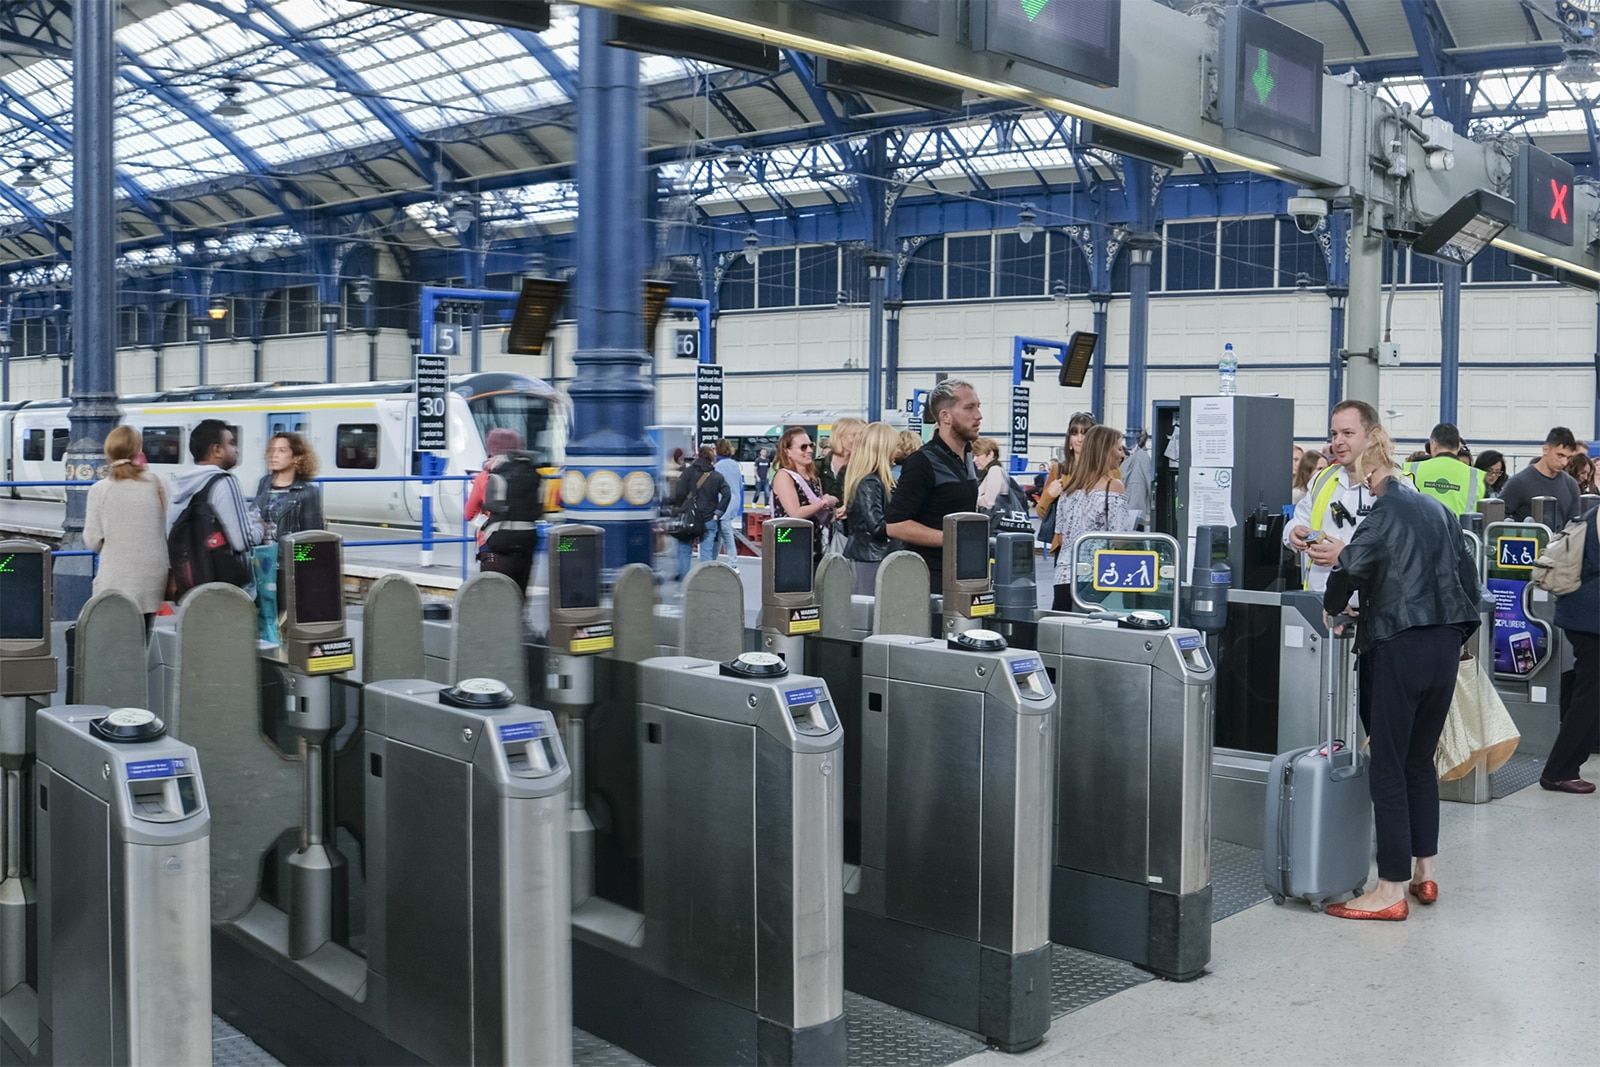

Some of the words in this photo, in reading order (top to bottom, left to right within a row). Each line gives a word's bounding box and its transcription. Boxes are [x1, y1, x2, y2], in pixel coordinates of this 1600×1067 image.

[440, 328, 454, 350] 5
[683, 334, 694, 354] 6
[1024, 362, 1032, 378] 7
[420, 397, 445, 417] 30
[701, 403, 720, 422] 30
[1014, 415, 1027, 430] 30
